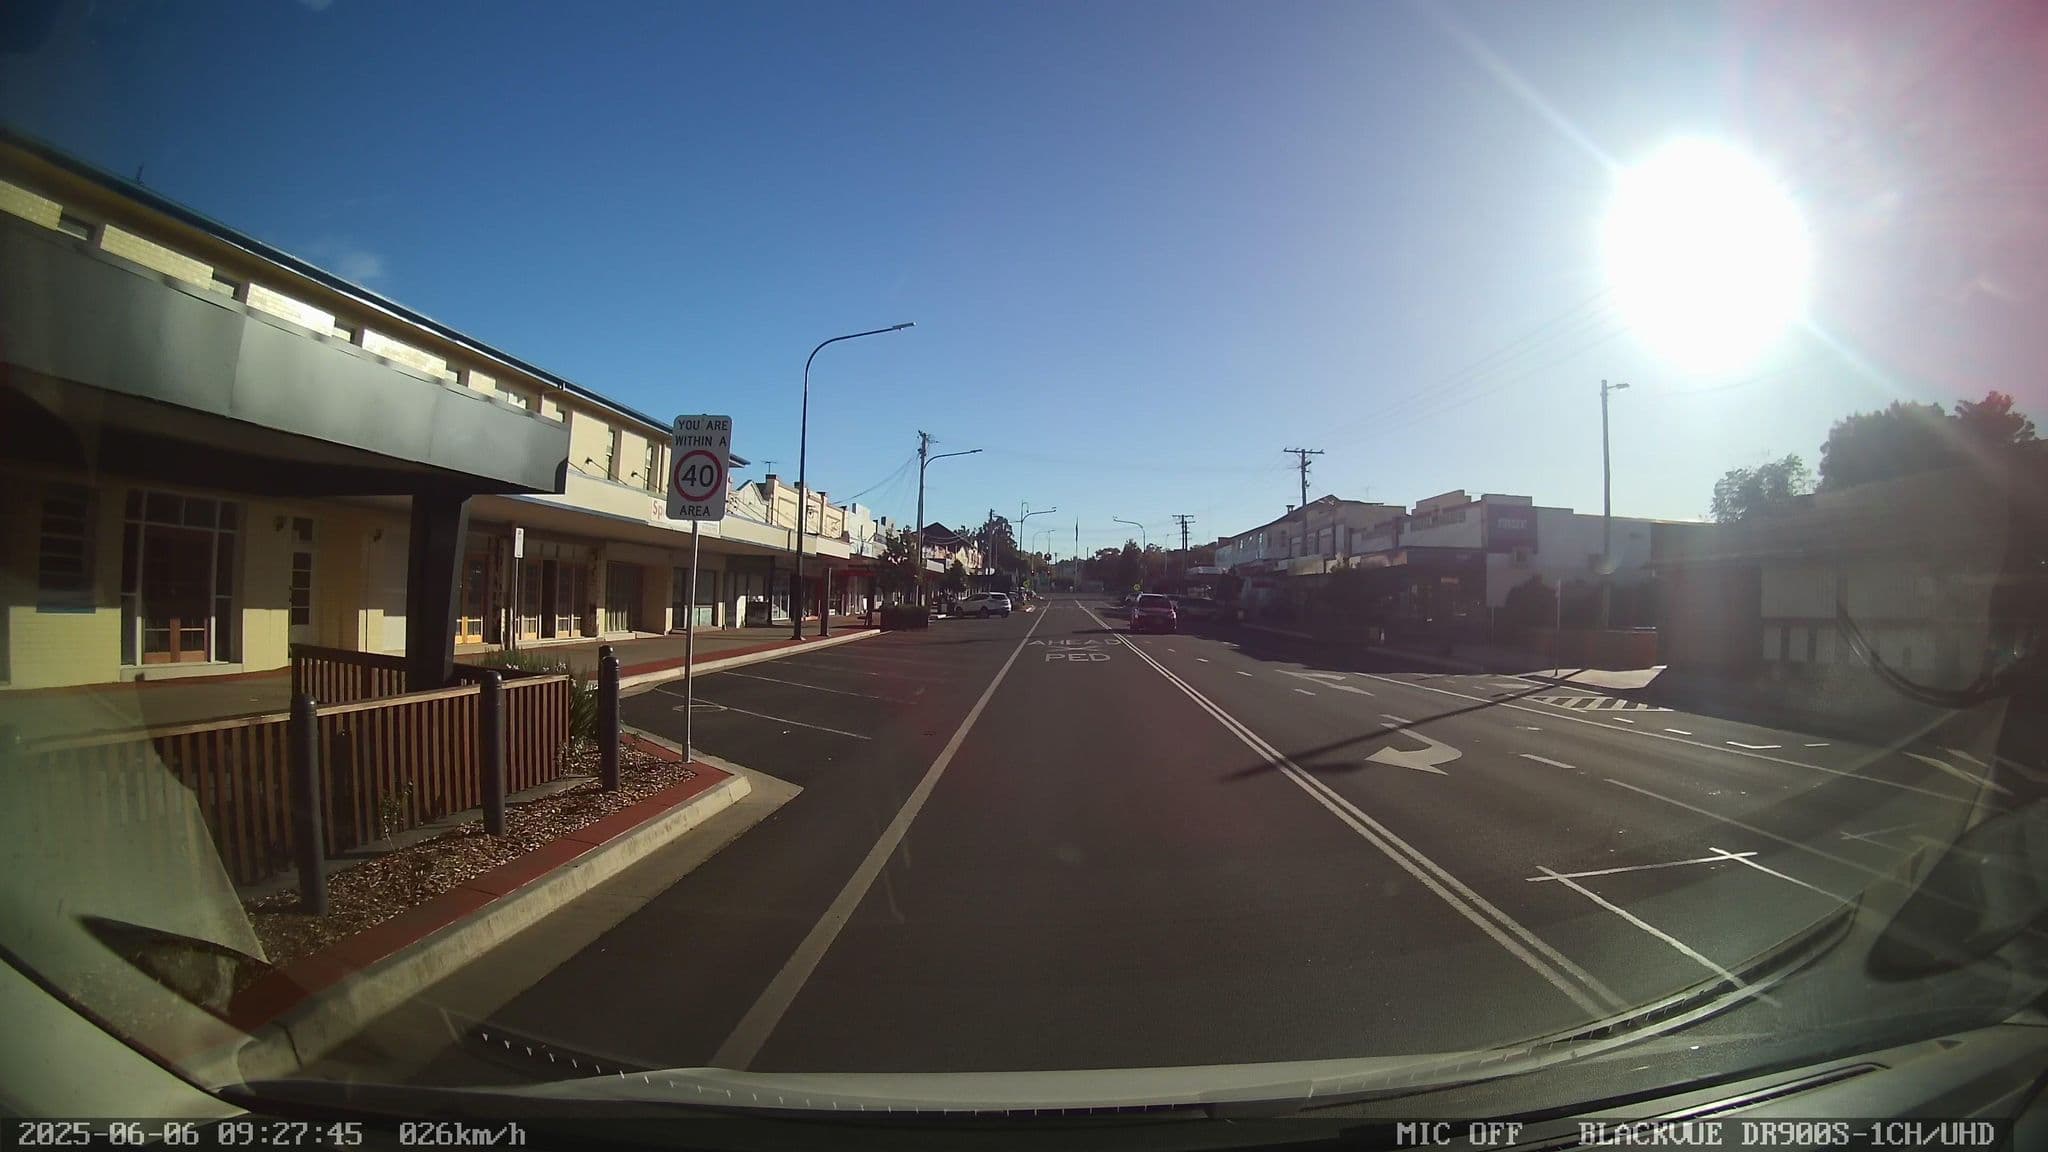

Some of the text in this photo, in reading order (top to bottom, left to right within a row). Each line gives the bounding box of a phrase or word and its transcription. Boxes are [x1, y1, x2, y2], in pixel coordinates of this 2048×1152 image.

[677, 420, 728, 431] YOU ARE
[675, 435, 727, 447] WITHIN A
[681, 464, 714, 488] 40
[679, 505, 711, 517] AREA
[1045, 653, 1111, 662] PED
